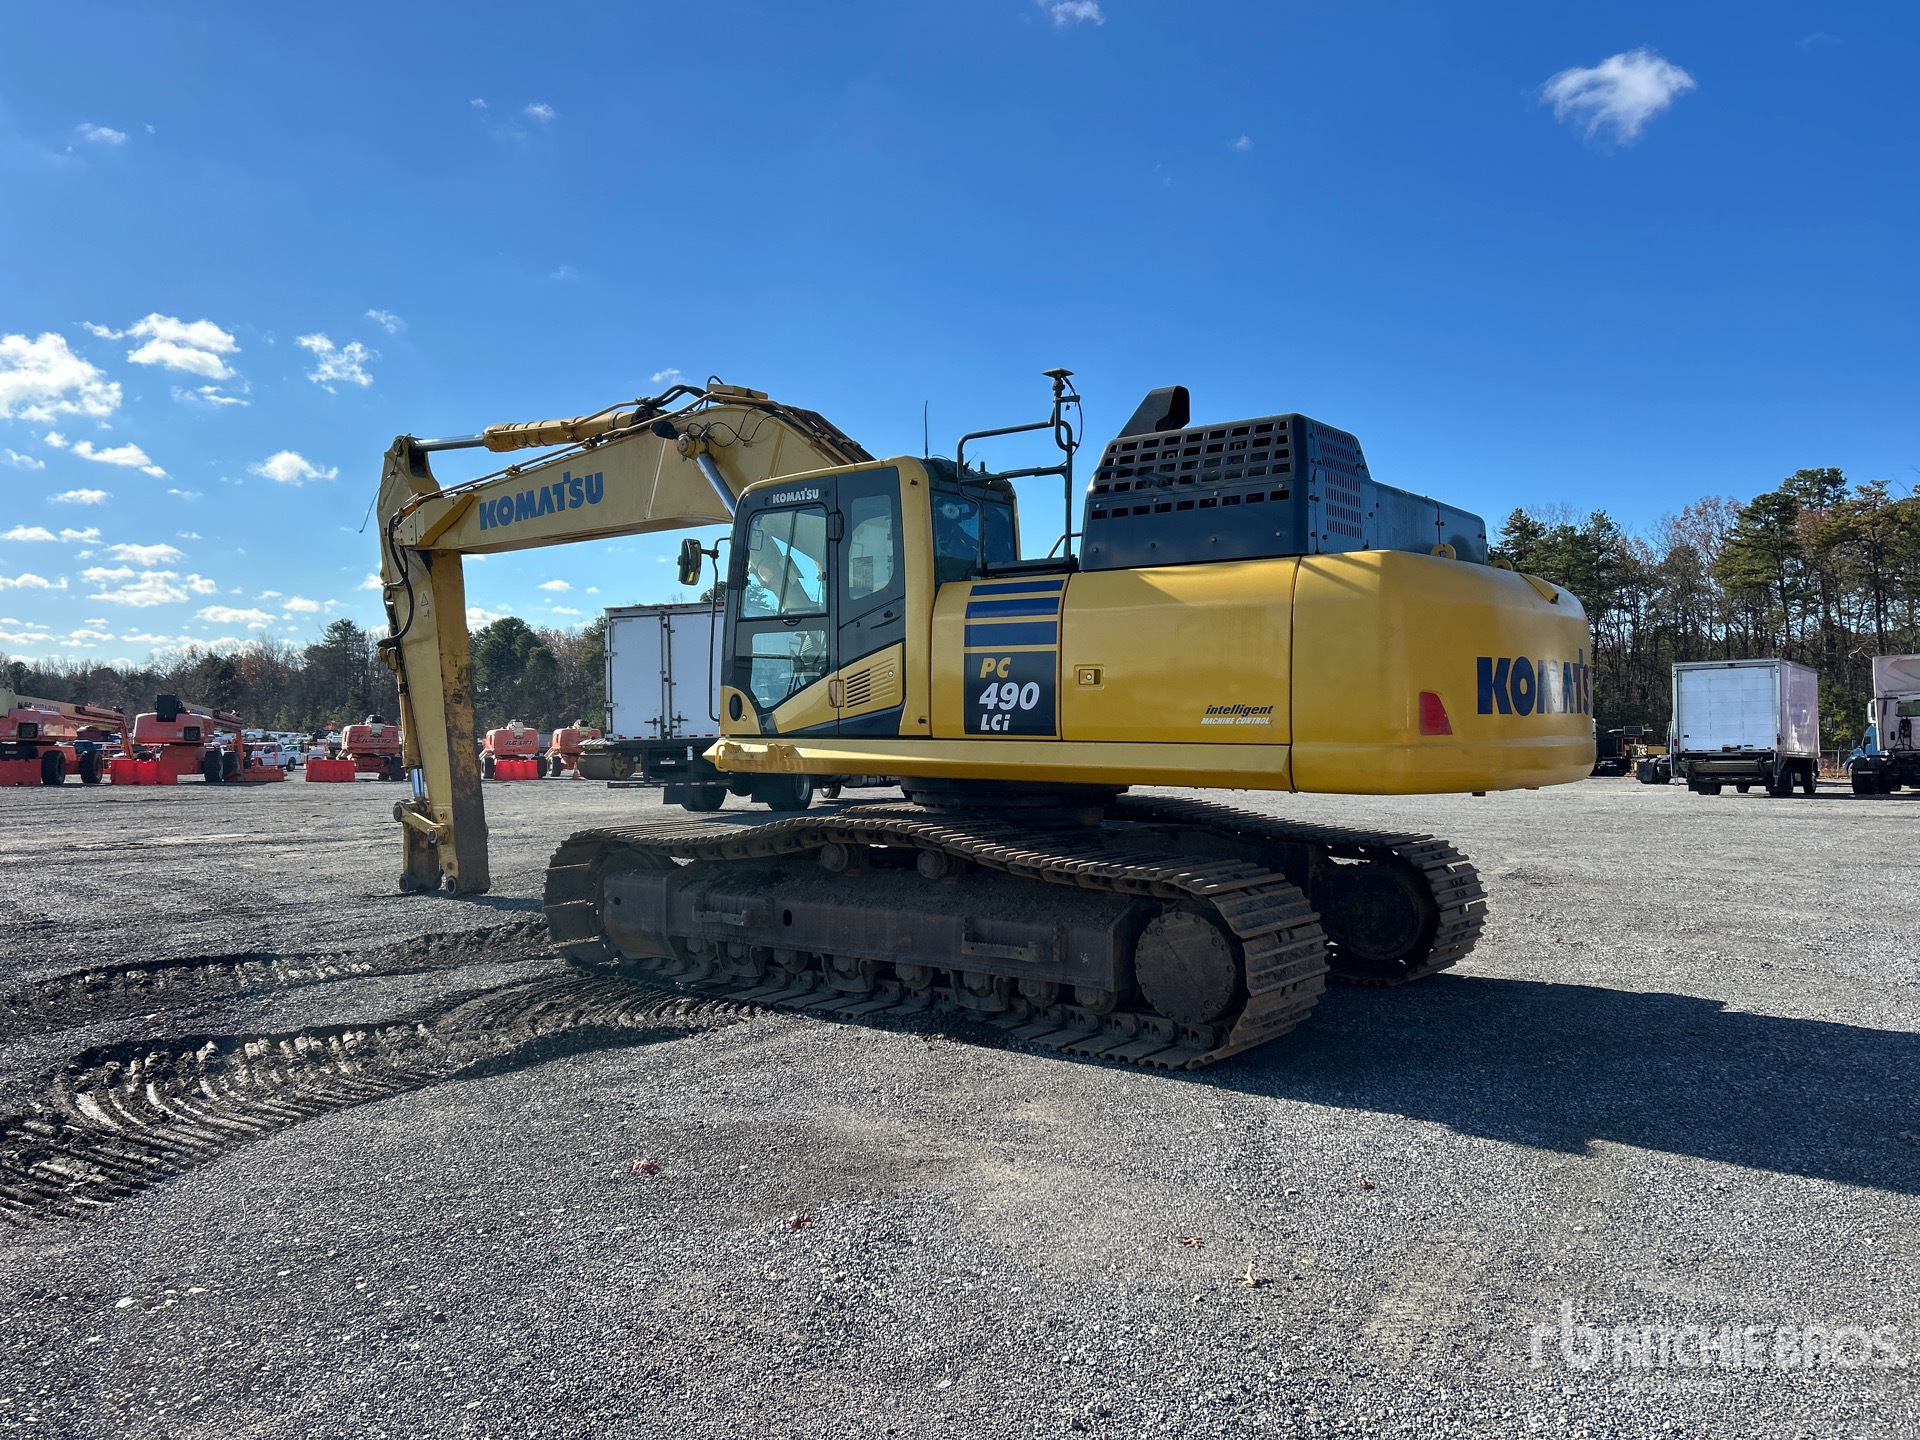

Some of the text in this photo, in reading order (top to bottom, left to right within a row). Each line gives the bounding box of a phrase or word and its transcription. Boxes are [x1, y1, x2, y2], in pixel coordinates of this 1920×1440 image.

[479, 471, 603, 532] KOMATSU
[772, 488, 820, 504] KOMATSU
[979, 657, 1011, 679] PC
[1476, 648, 1593, 716] KOMATS
[978, 682, 1040, 711] 490
[1205, 704, 1274, 717] intelligent
[980, 713, 1010, 731] LCi
[1200, 717, 1270, 725] MACHINE CONTROL
